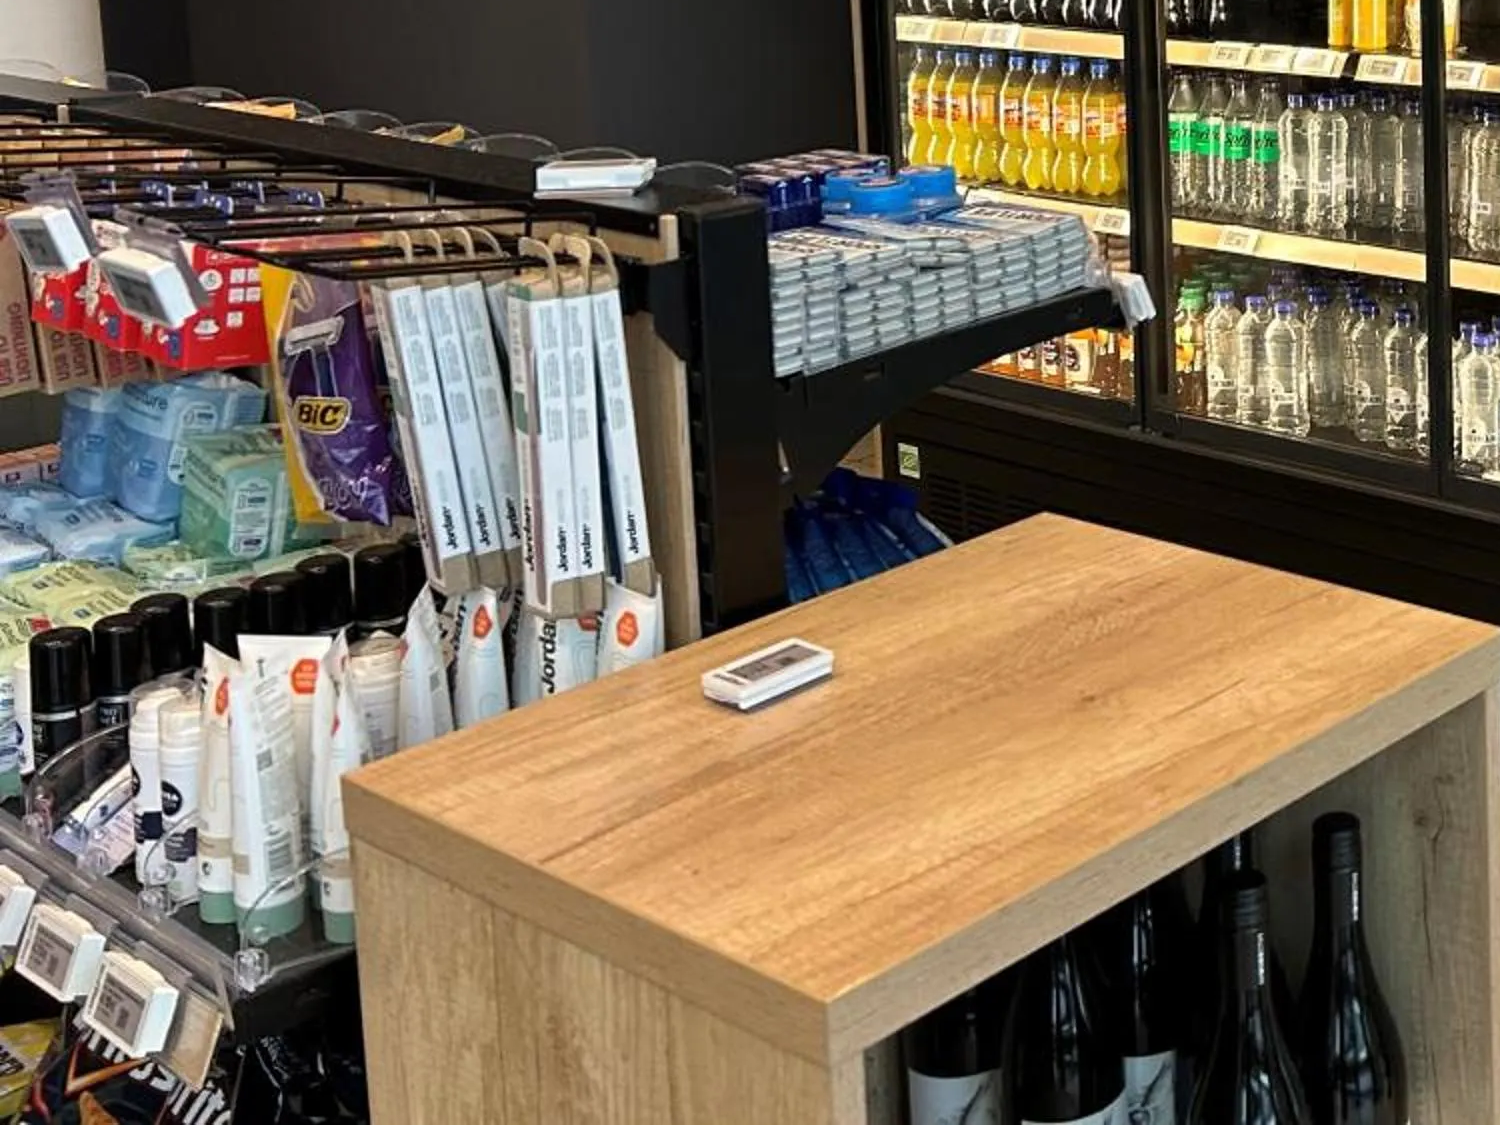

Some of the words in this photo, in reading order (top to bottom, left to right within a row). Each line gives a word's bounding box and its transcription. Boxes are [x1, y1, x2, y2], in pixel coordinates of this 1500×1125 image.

[8, 302, 31, 383] LIGHTNING
[441, 506, 458, 550] Jordan
[475, 503, 491, 546] Jordan
[505, 497, 521, 540] Jordan
[625, 510, 639, 554] Jordan
[556, 526, 569, 572] Jordan
[580, 523, 592, 569] Jordan
[539, 620, 558, 694] Jorda
